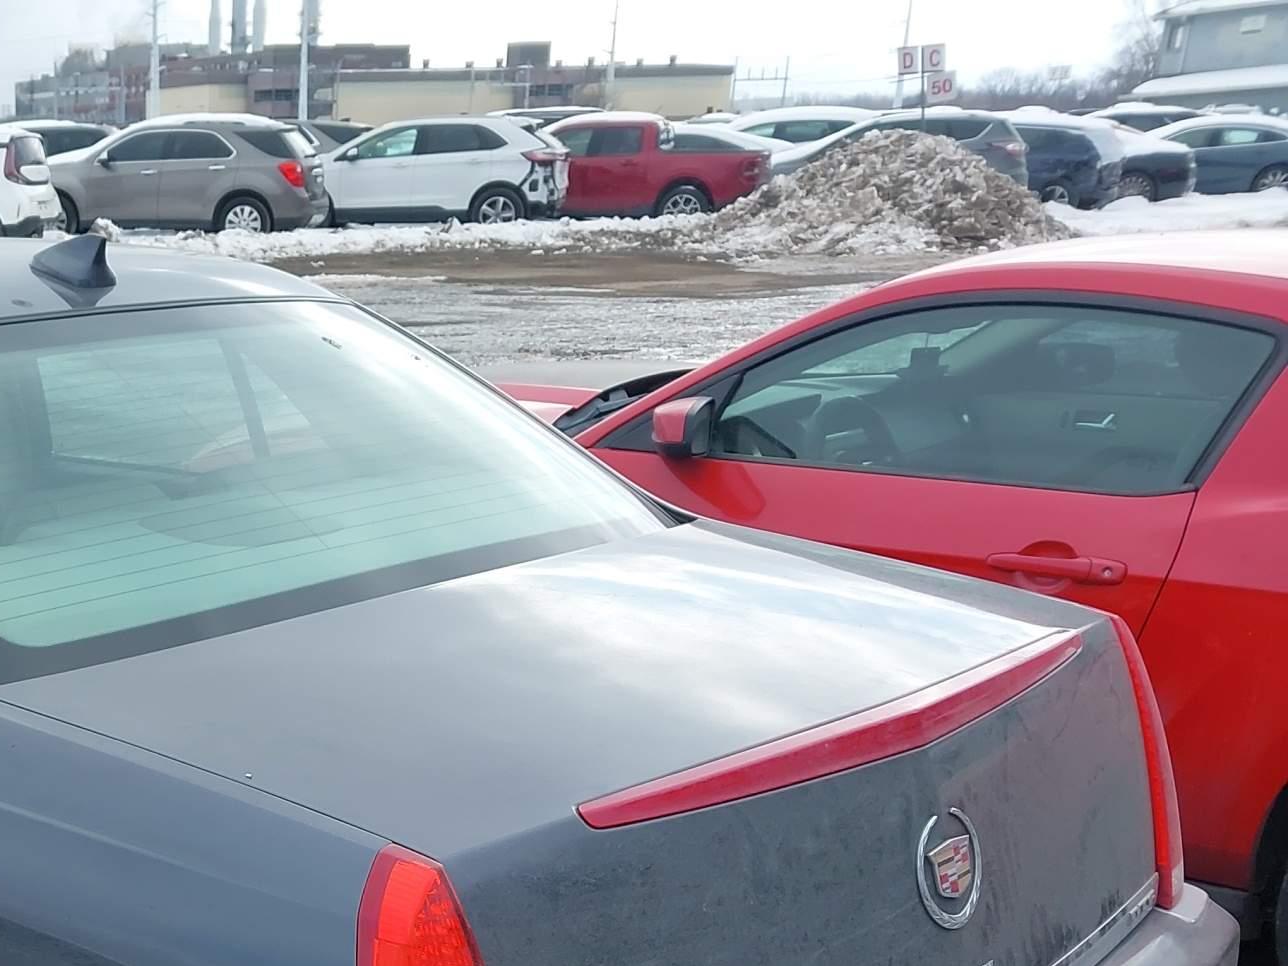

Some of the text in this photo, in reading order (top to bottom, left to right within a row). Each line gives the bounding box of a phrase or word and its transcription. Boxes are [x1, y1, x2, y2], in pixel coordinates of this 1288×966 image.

[903, 52, 913, 69] D
[929, 49, 940, 67] C
[931, 78, 952, 96] 50
